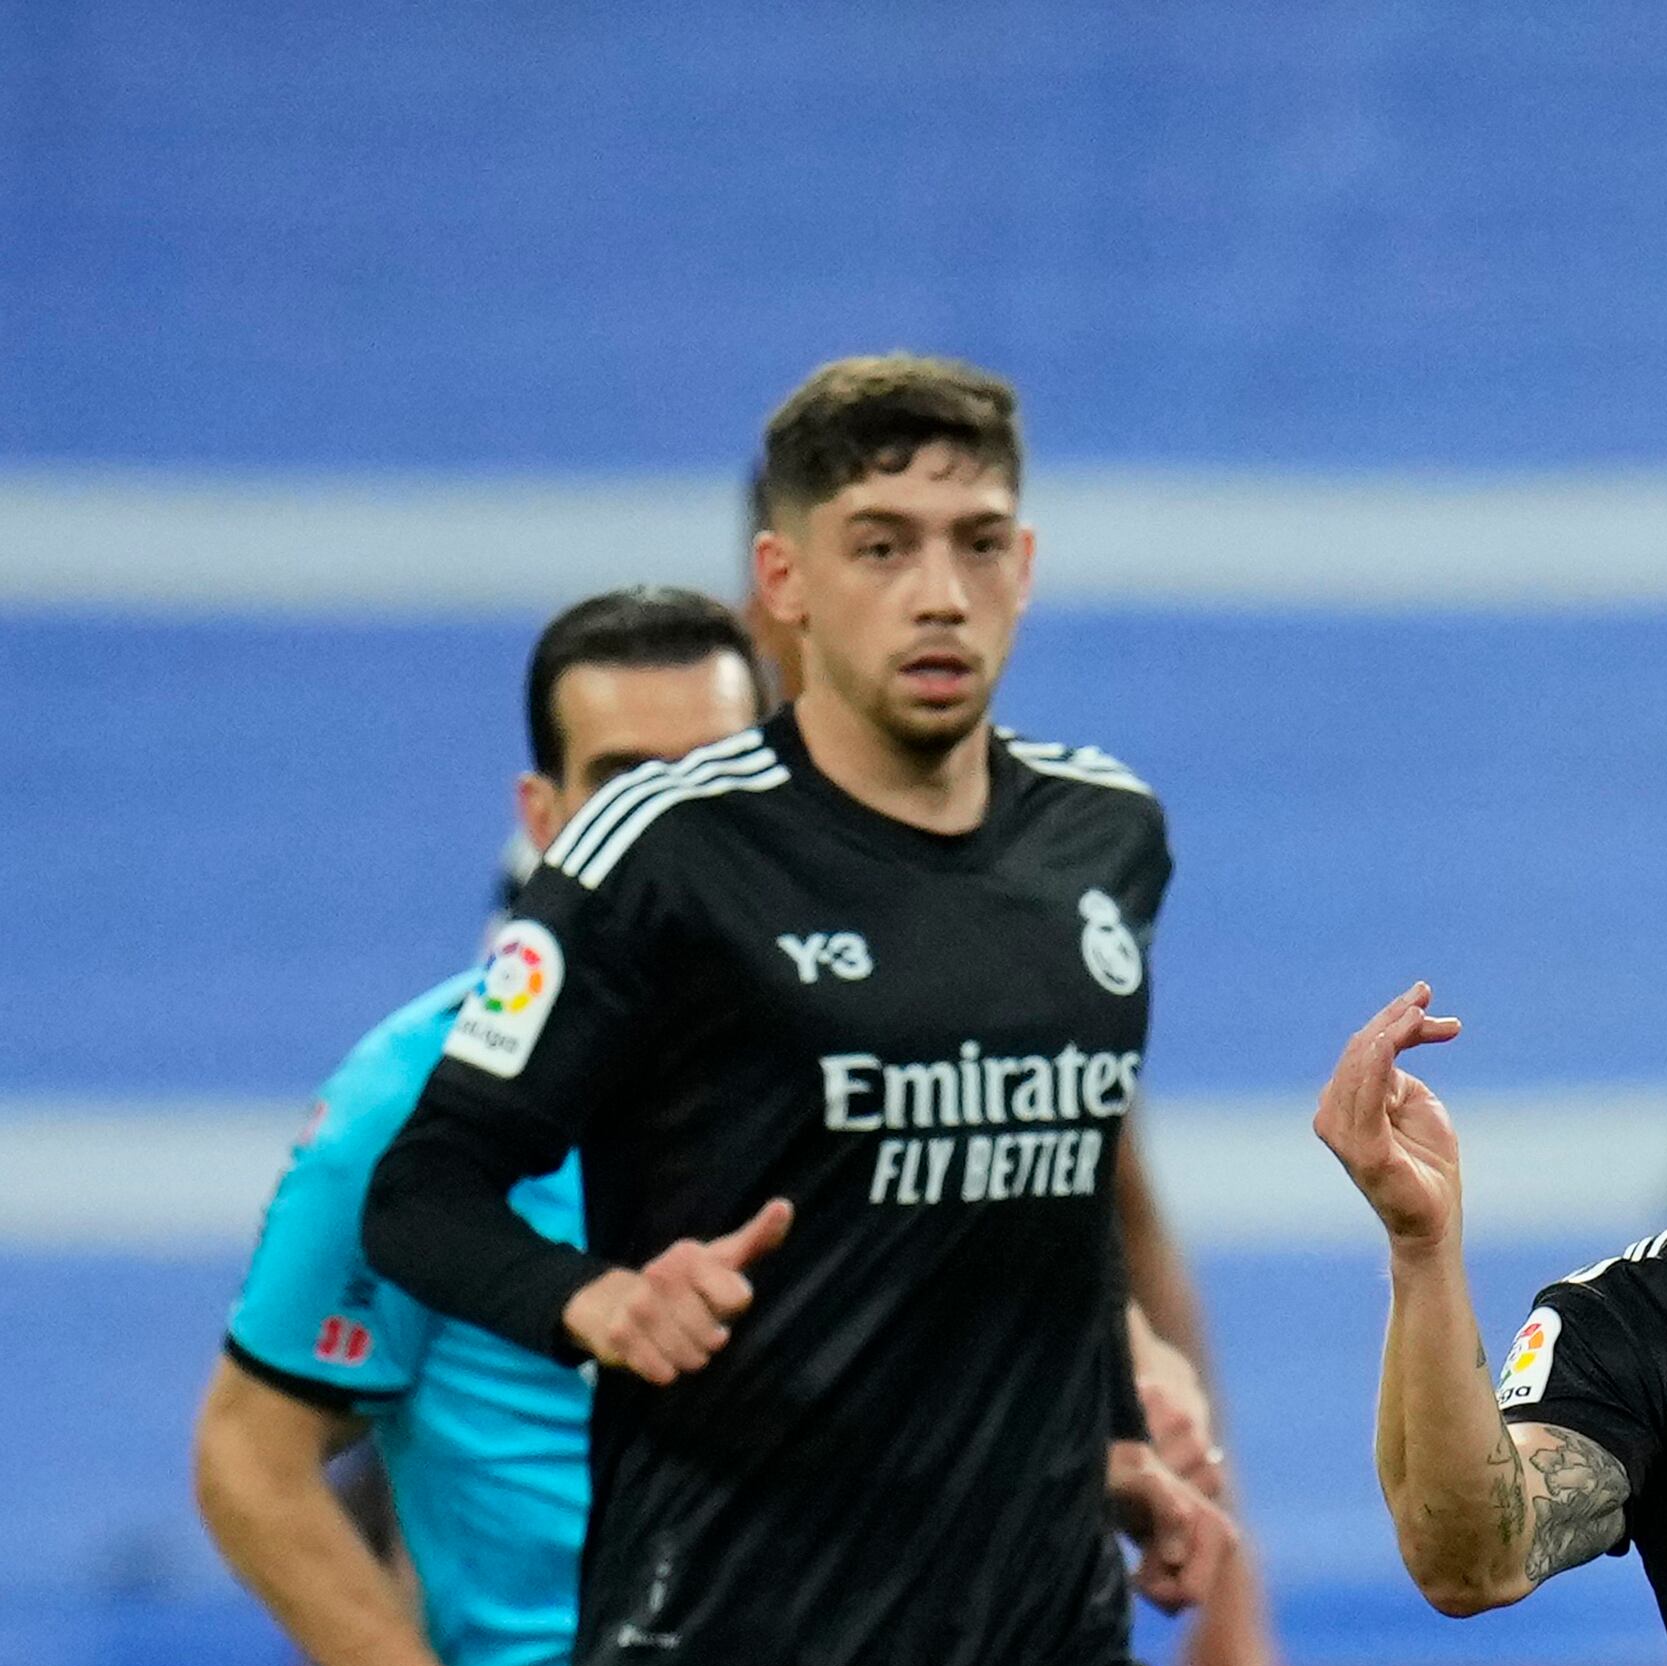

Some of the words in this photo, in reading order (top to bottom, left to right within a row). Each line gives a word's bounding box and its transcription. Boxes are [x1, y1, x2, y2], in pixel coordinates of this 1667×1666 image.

[776, 932, 873, 984] Y-3
[820, 1040, 1140, 1131] Emirates
[869, 1139, 955, 1204] FLY
[962, 1129, 1102, 1201] BETTER
